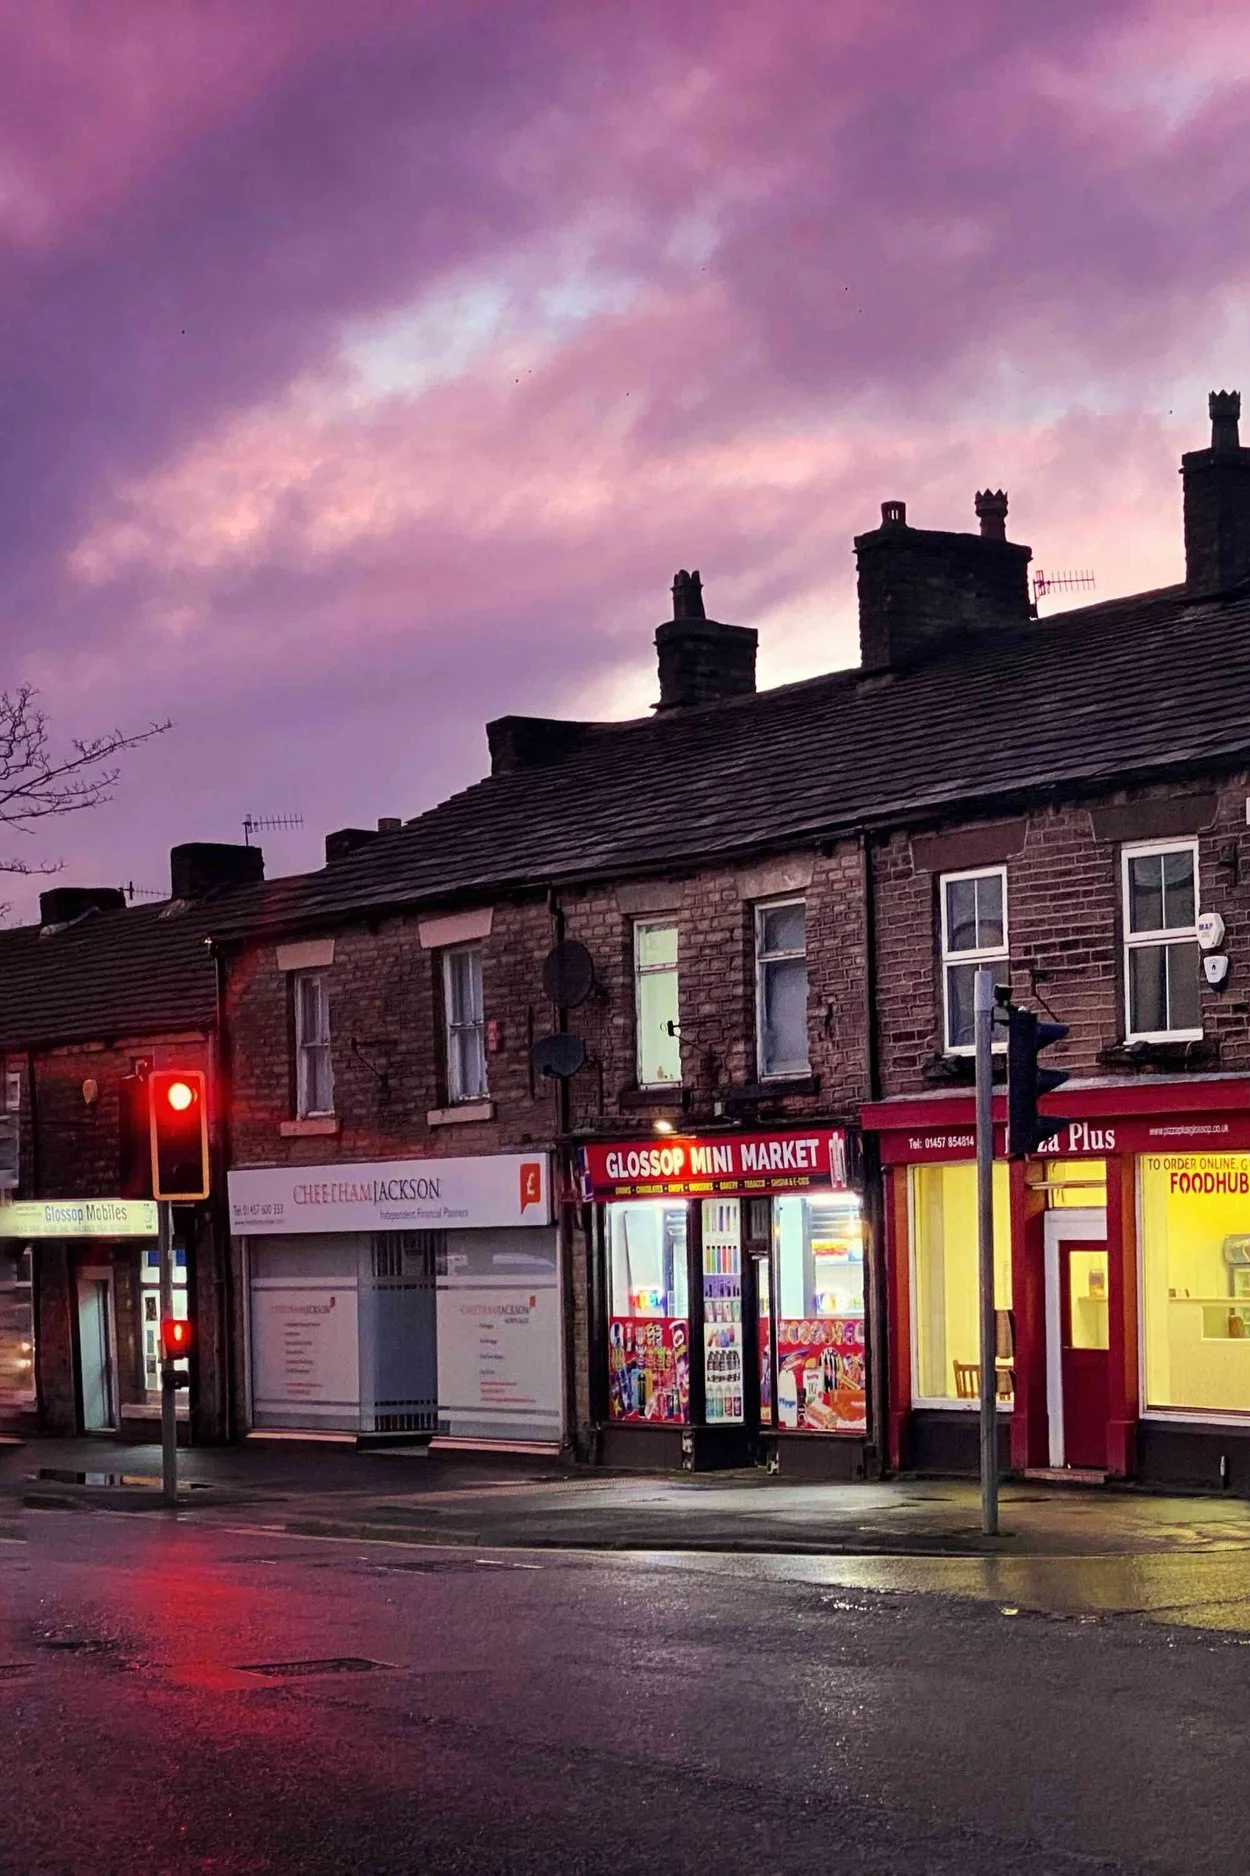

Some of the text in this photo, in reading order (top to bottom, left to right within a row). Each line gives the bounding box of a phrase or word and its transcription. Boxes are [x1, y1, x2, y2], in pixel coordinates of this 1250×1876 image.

[908, 1135, 975, 1149] Tel: 01457 854814
[1068, 1121, 1116, 1151] Plus
[605, 1138, 819, 1178] GLOSSOP MINI MARKET
[1148, 1158, 1160, 1170] TO
[1163, 1158, 1197, 1170] ORDER
[293, 1177, 441, 1205] CHEETHAMJACKSON
[1170, 1172, 1249, 1195] FOODHUB
[45, 1205, 84, 1224] Glossop
[86, 1204, 127, 1221] Mobiles
